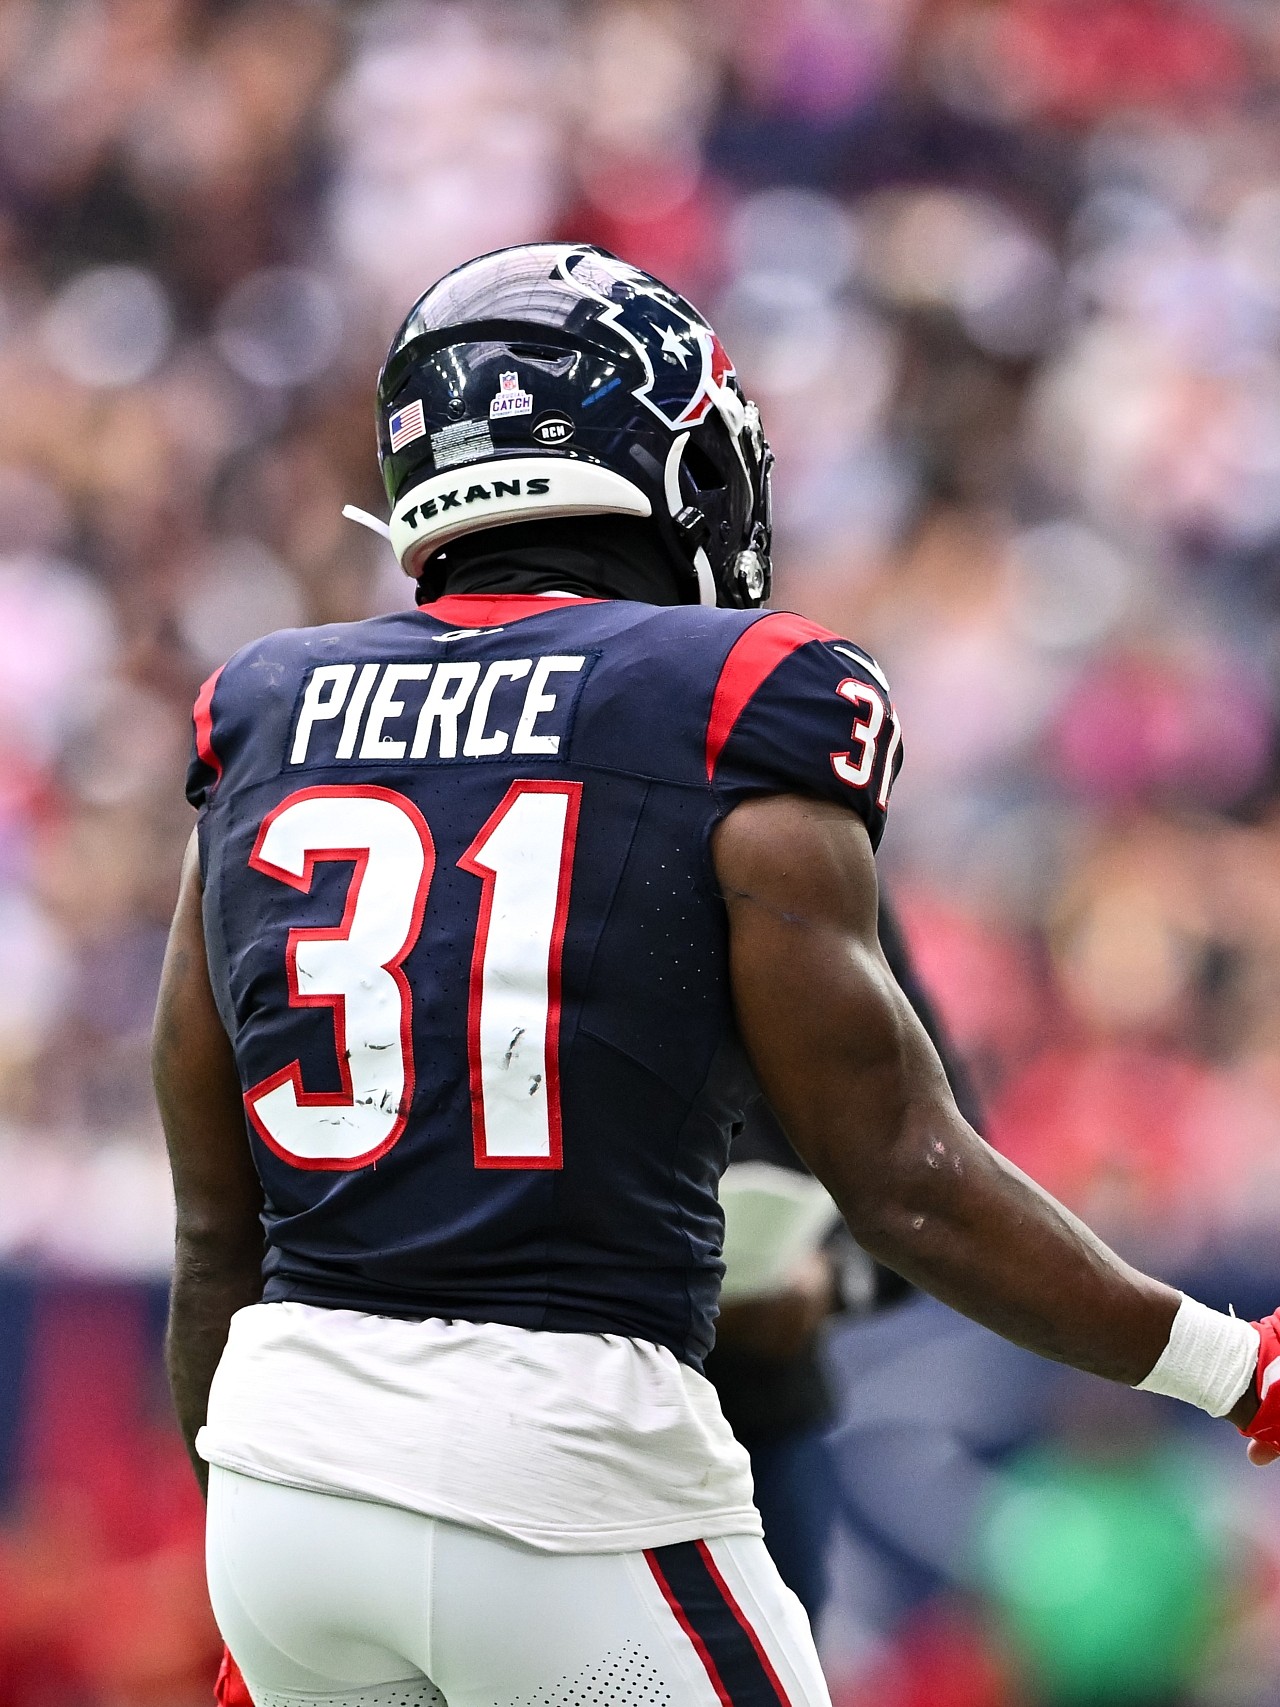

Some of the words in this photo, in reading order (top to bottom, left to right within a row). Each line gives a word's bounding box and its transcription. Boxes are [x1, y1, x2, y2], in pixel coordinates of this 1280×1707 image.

[492, 396, 530, 412] CATCH
[541, 425, 565, 439] RCM
[401, 478, 550, 529] TEXANS
[290, 656, 586, 764] PIERCE
[830, 677, 904, 812] 31
[243, 779, 583, 1171] 31
